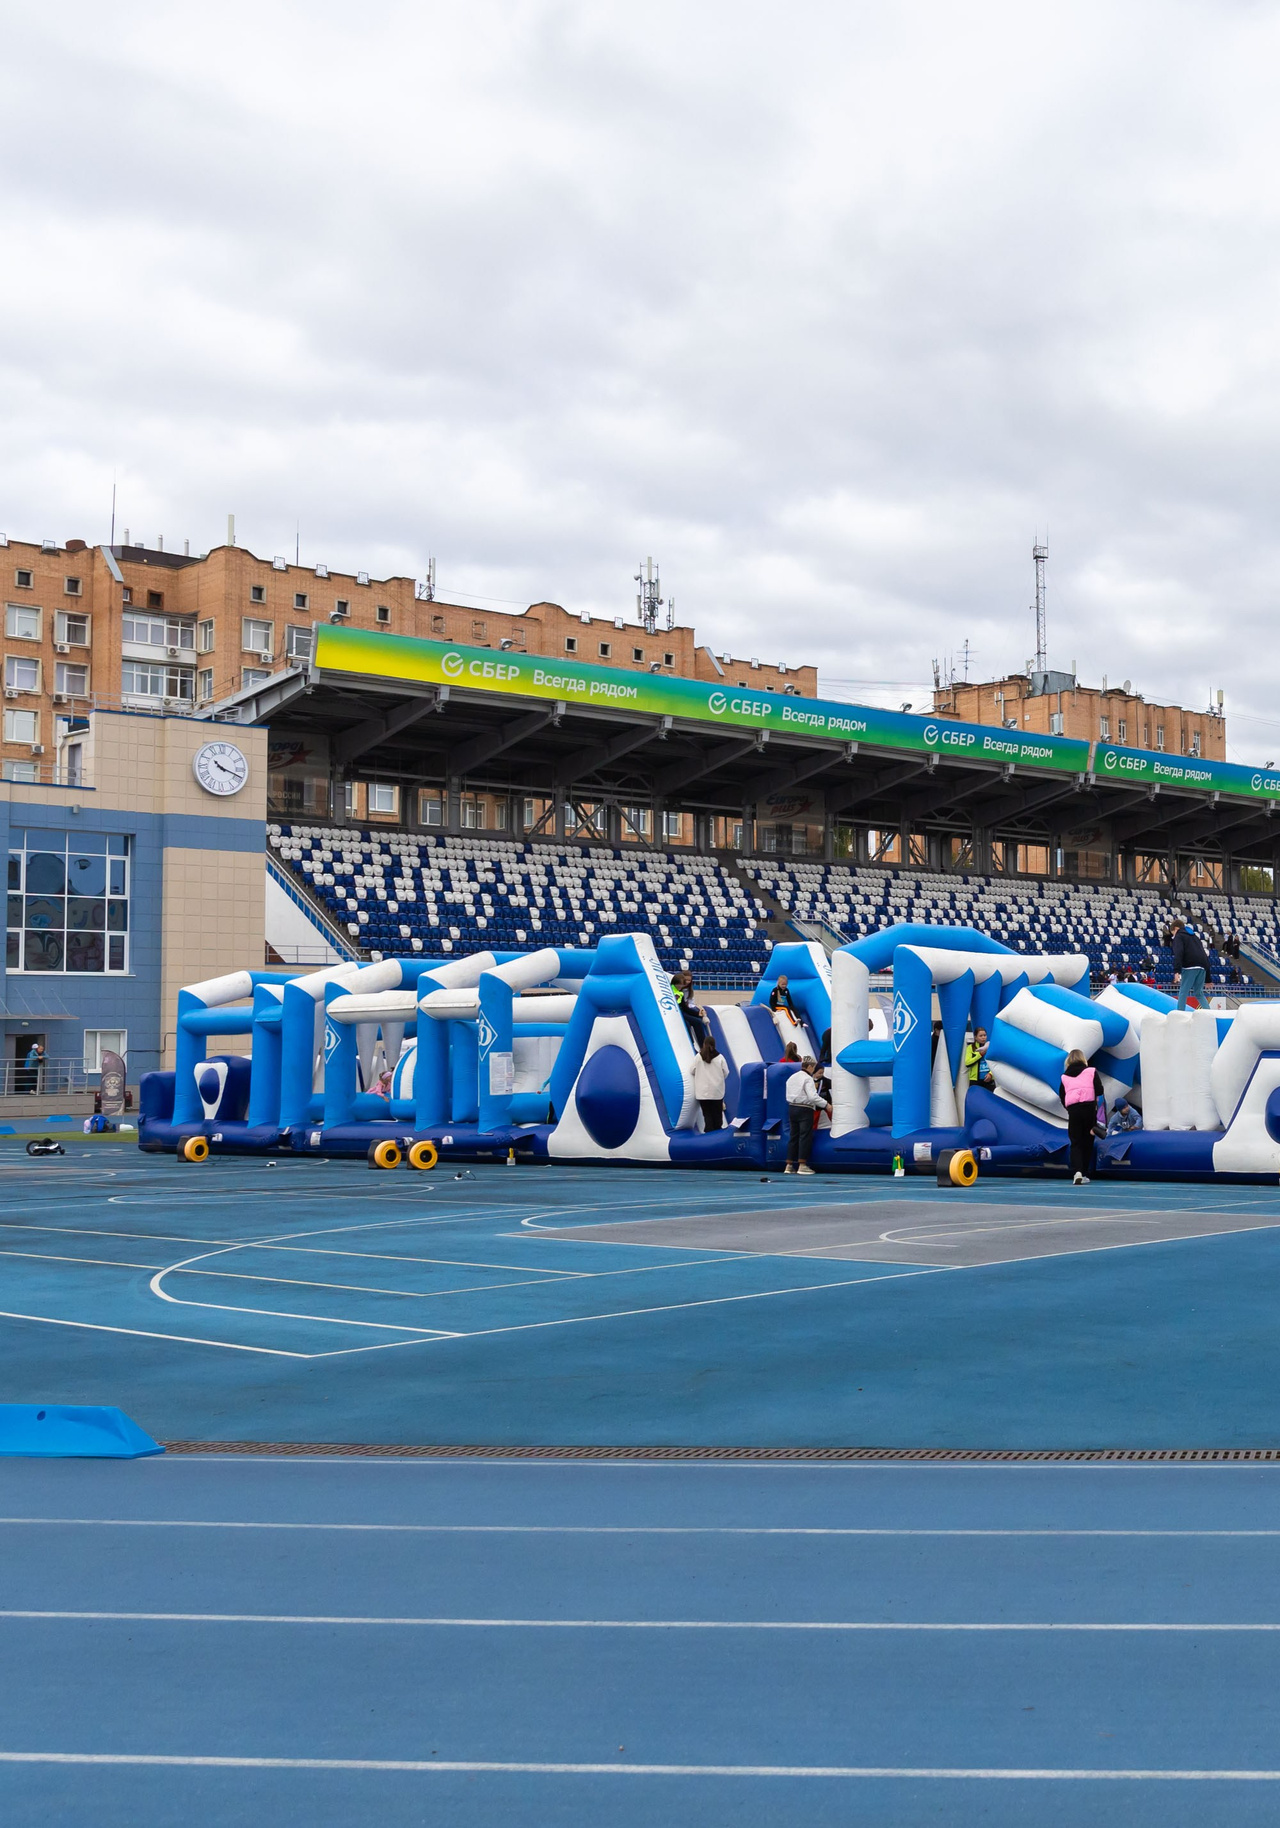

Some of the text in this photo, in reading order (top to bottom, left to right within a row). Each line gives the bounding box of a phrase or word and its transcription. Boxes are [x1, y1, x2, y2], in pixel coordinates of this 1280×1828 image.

[469, 660, 638, 699] СБЕР Всегда рядом
[730, 699, 867, 732] СБЕР Всегда рядом
[941, 730, 1053, 758] СБЕР Всегда рядом
[1119, 756, 1212, 781] СБЕР Всегда рядом
